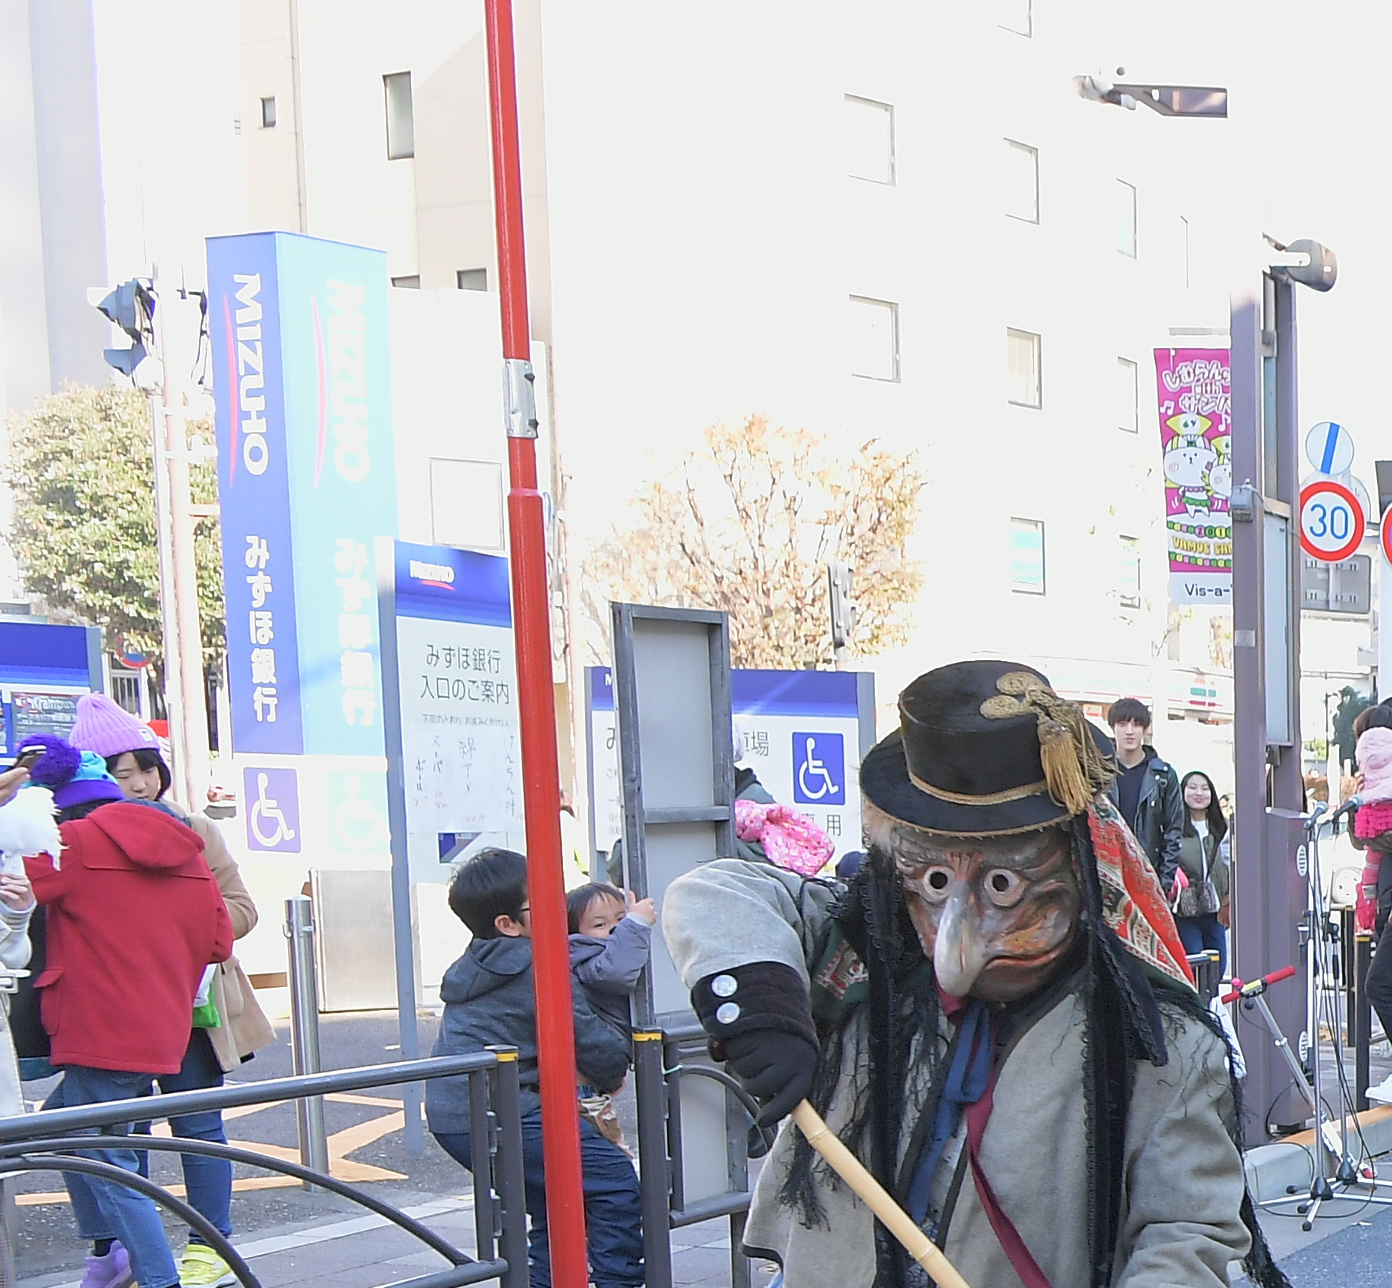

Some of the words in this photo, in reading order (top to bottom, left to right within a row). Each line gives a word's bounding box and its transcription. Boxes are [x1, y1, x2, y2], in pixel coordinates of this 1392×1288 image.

[234, 272, 270, 476] MIZUHO
[327, 278, 371, 484] MIZUHO
[1309, 504, 1349, 540] 30
[244, 535, 279, 723] みずほ銀行
[333, 538, 377, 727] みずほ銀行
[1184, 583, 1232, 597] Vis-a-
[420, 676, 510, 705] 入口のご案内
[426, 644, 501, 674] みずほ銀行
